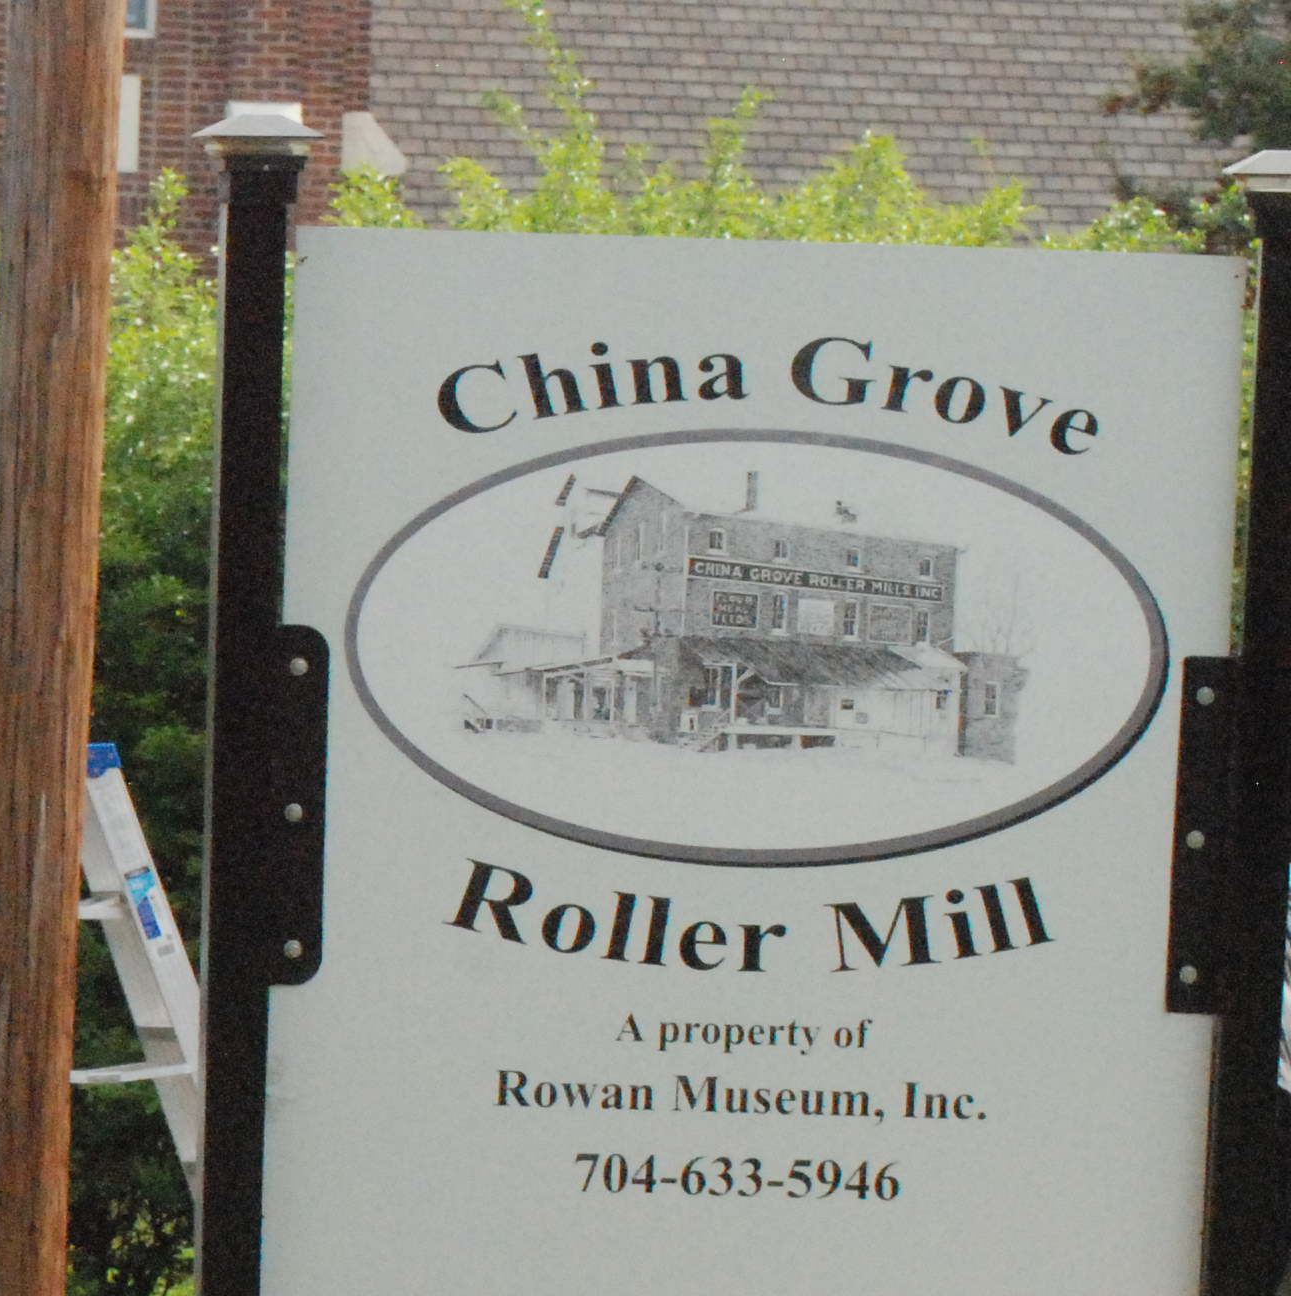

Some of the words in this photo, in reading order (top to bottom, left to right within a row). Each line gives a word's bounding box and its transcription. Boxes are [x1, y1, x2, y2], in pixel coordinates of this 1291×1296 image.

[436, 341, 749, 435] China
[790, 335, 1101, 457] Grove
[694, 562, 742, 580] CHINA
[750, 567, 803, 587] GROVE
[809, 575, 866, 592] ROLLER
[443, 858, 788, 974] Roller
[823, 876, 1057, 974] Mill
[616, 1012, 644, 1044] A
[657, 1017, 823, 1056] property
[832, 1020, 873, 1050] of
[494, 1069, 655, 1111] Rowan
[672, 1074, 886, 1126] Museum,
[902, 1080, 988, 1121] Inc.
[575, 1152, 901, 1201] 704-633-5946
